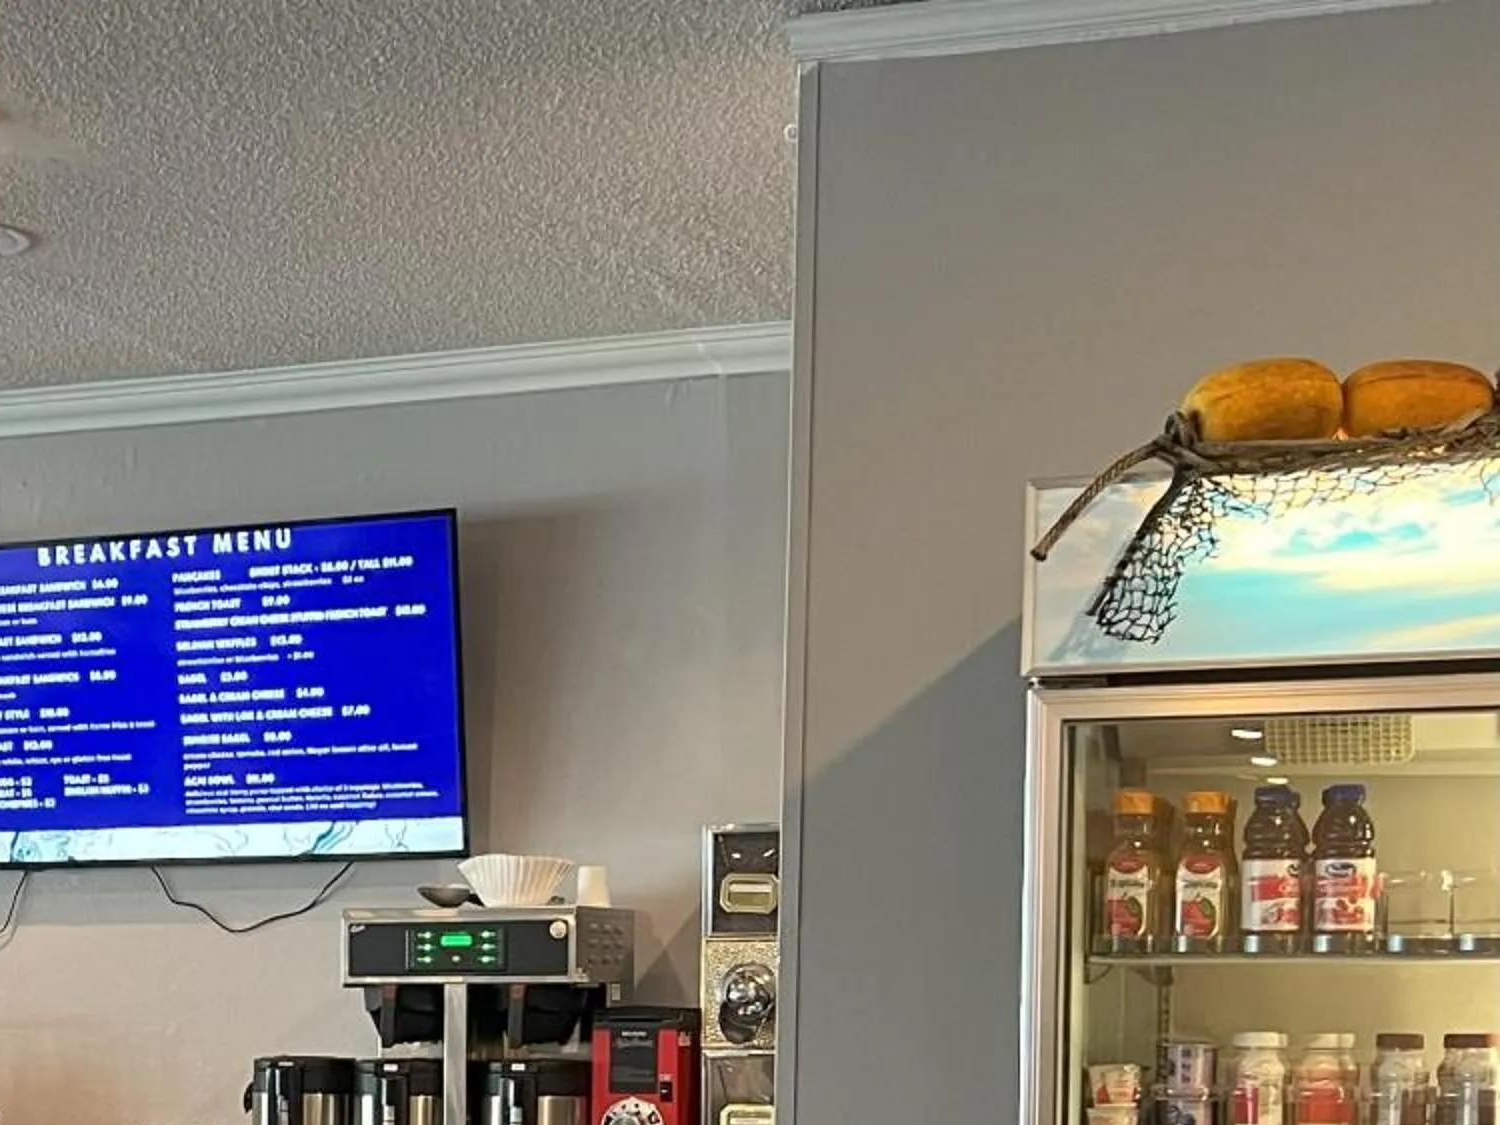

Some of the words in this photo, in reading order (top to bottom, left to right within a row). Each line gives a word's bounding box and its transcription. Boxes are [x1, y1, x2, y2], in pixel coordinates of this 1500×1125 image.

[37, 535, 197, 567] BREAKFAST
[213, 528, 291, 554] MENU
[282, 563, 312, 575] STACK
